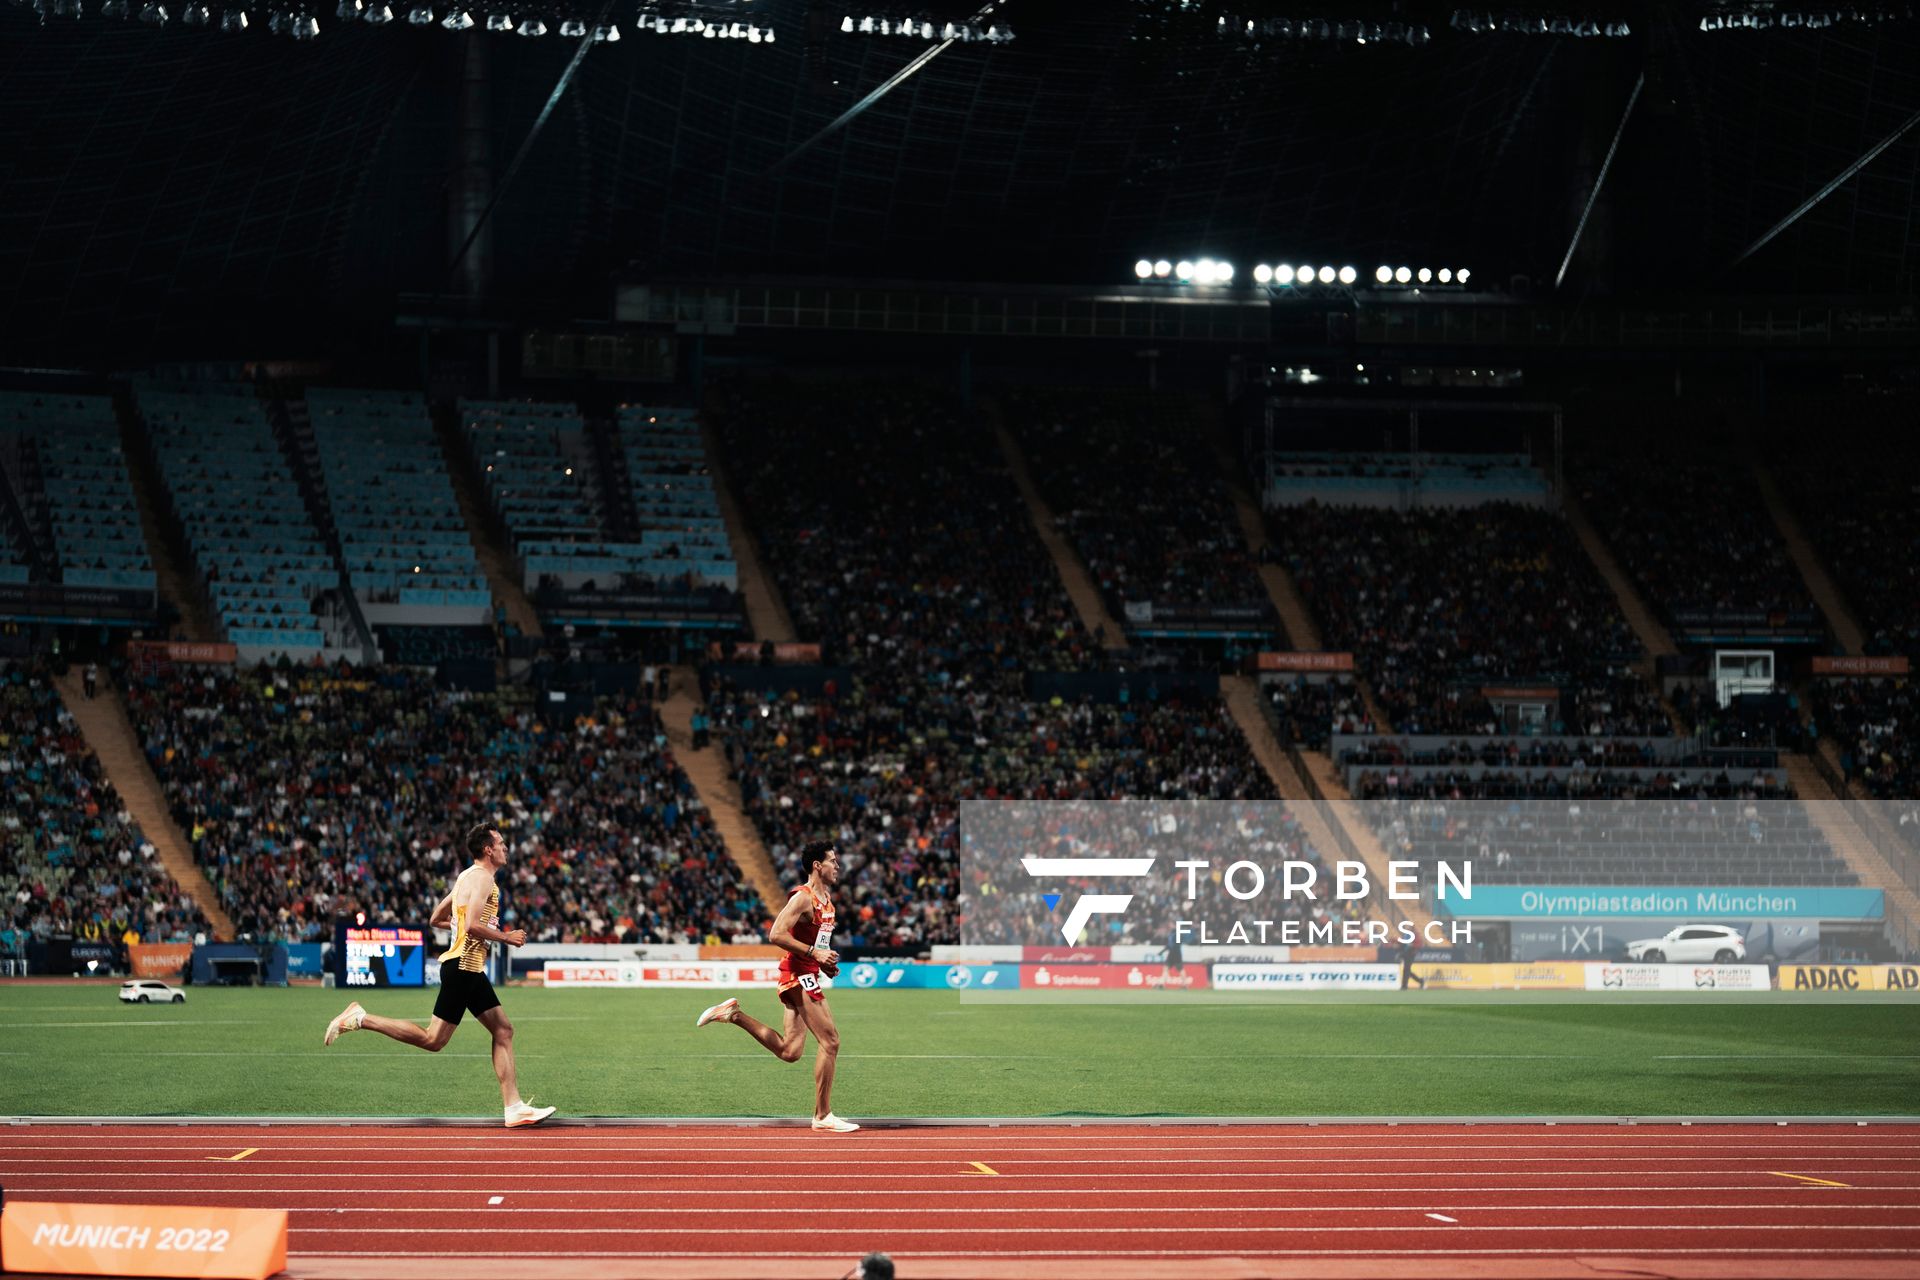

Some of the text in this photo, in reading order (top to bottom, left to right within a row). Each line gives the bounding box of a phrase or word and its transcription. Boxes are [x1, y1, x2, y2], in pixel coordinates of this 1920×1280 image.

[1521, 892, 1797, 915] Olympiastadion München
[1561, 925, 1603, 954] iX1
[142, 954, 184, 967] MUNICH
[563, 969, 618, 981] SPAR
[657, 969, 714, 981] SPAR
[1053, 975, 1101, 986] Sparkasse
[1216, 973, 1304, 982] TOYO TIRES
[1310, 972, 1398, 982] TOYO TIRES
[1795, 968, 1859, 990] ADAC
[801, 977, 815, 988] 15
[32, 1223, 230, 1252] MUNICH 2022
